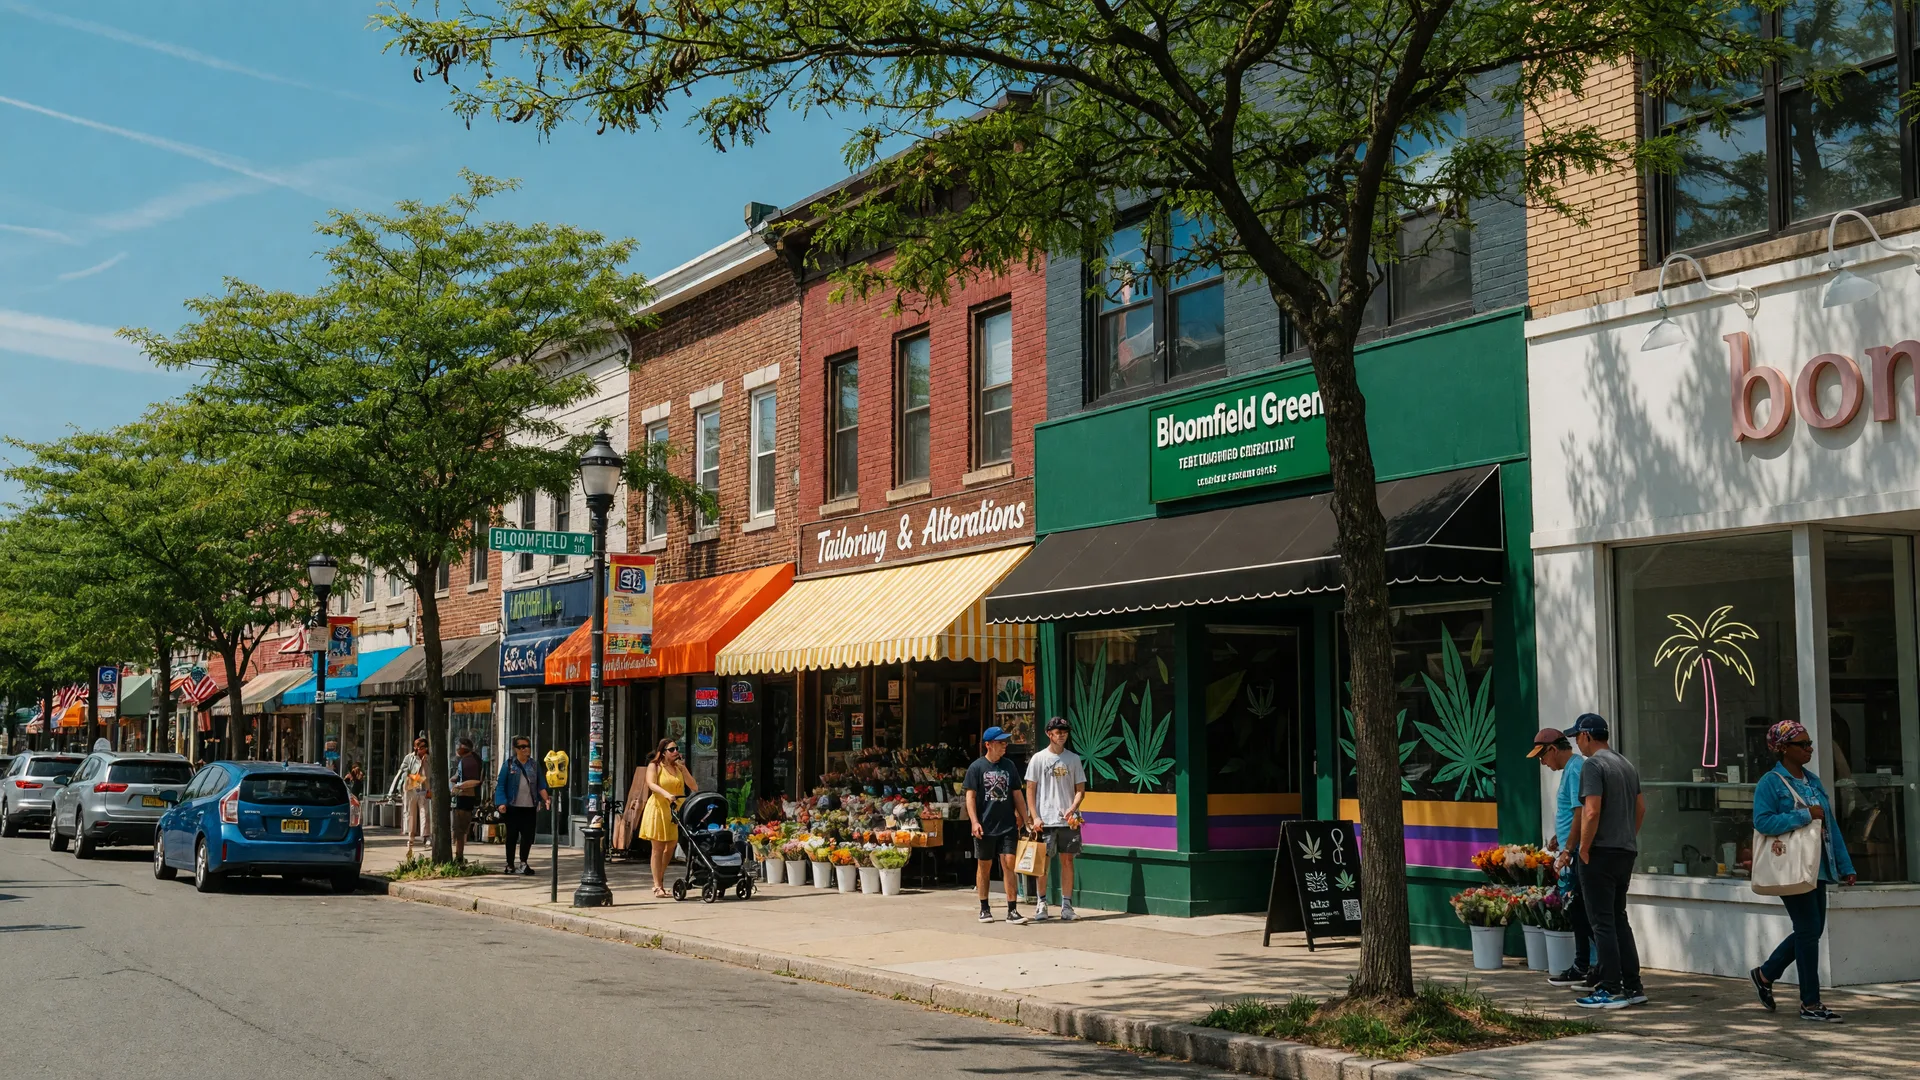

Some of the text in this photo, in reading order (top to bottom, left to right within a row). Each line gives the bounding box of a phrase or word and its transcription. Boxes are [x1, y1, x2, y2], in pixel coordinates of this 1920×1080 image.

[1723, 331, 1920, 443] bon
[1157, 396, 1257, 448] Bloomfield
[1261, 390, 1325, 426] Green
[495, 530, 567, 550] BLOOMFIELD
[817, 499, 1026, 563] Tailoring & Alterations
